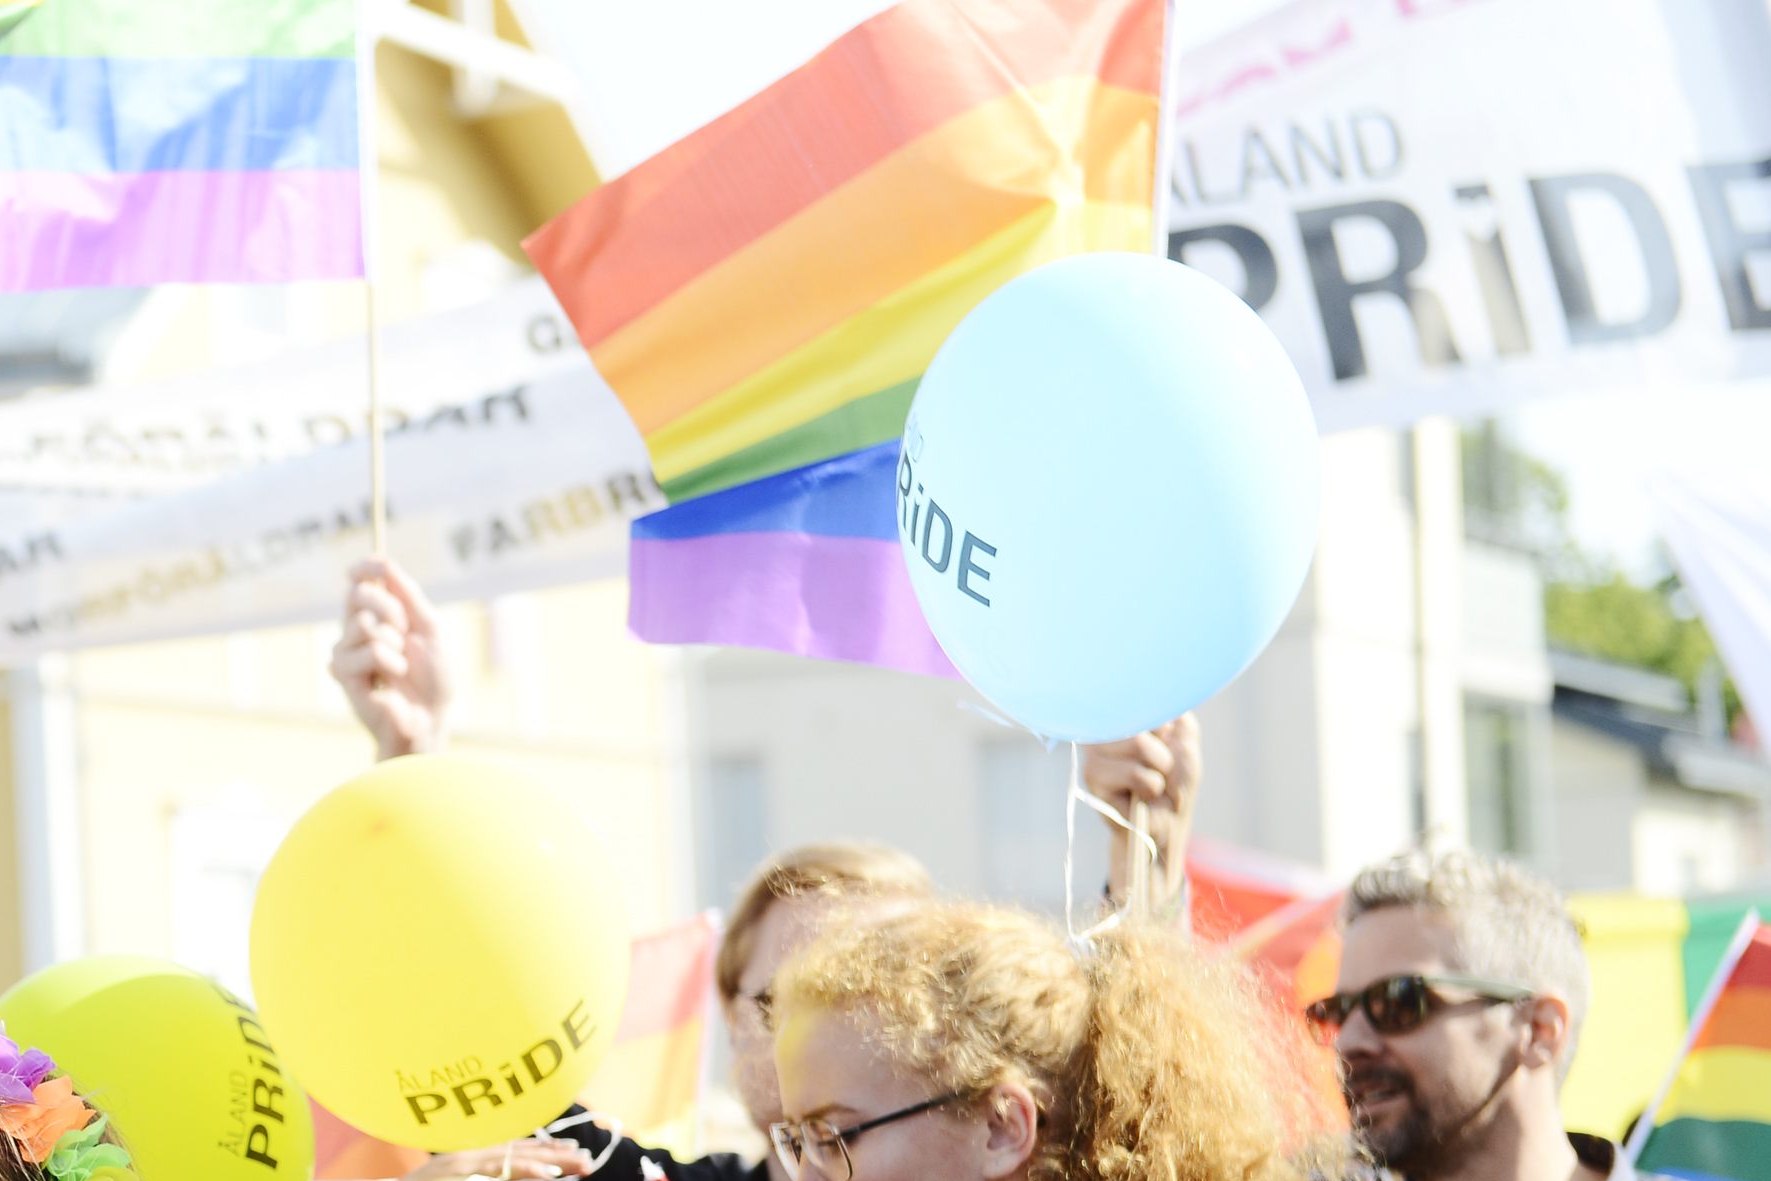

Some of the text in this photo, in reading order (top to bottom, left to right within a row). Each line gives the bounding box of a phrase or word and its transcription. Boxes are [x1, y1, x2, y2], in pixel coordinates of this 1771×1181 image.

[896, 450, 997, 608] RiDE
[218, 1070, 248, 1157] ÅLAND
[394, 1055, 483, 1092] ÅLAND
[405, 1000, 597, 1125] PRiDE
